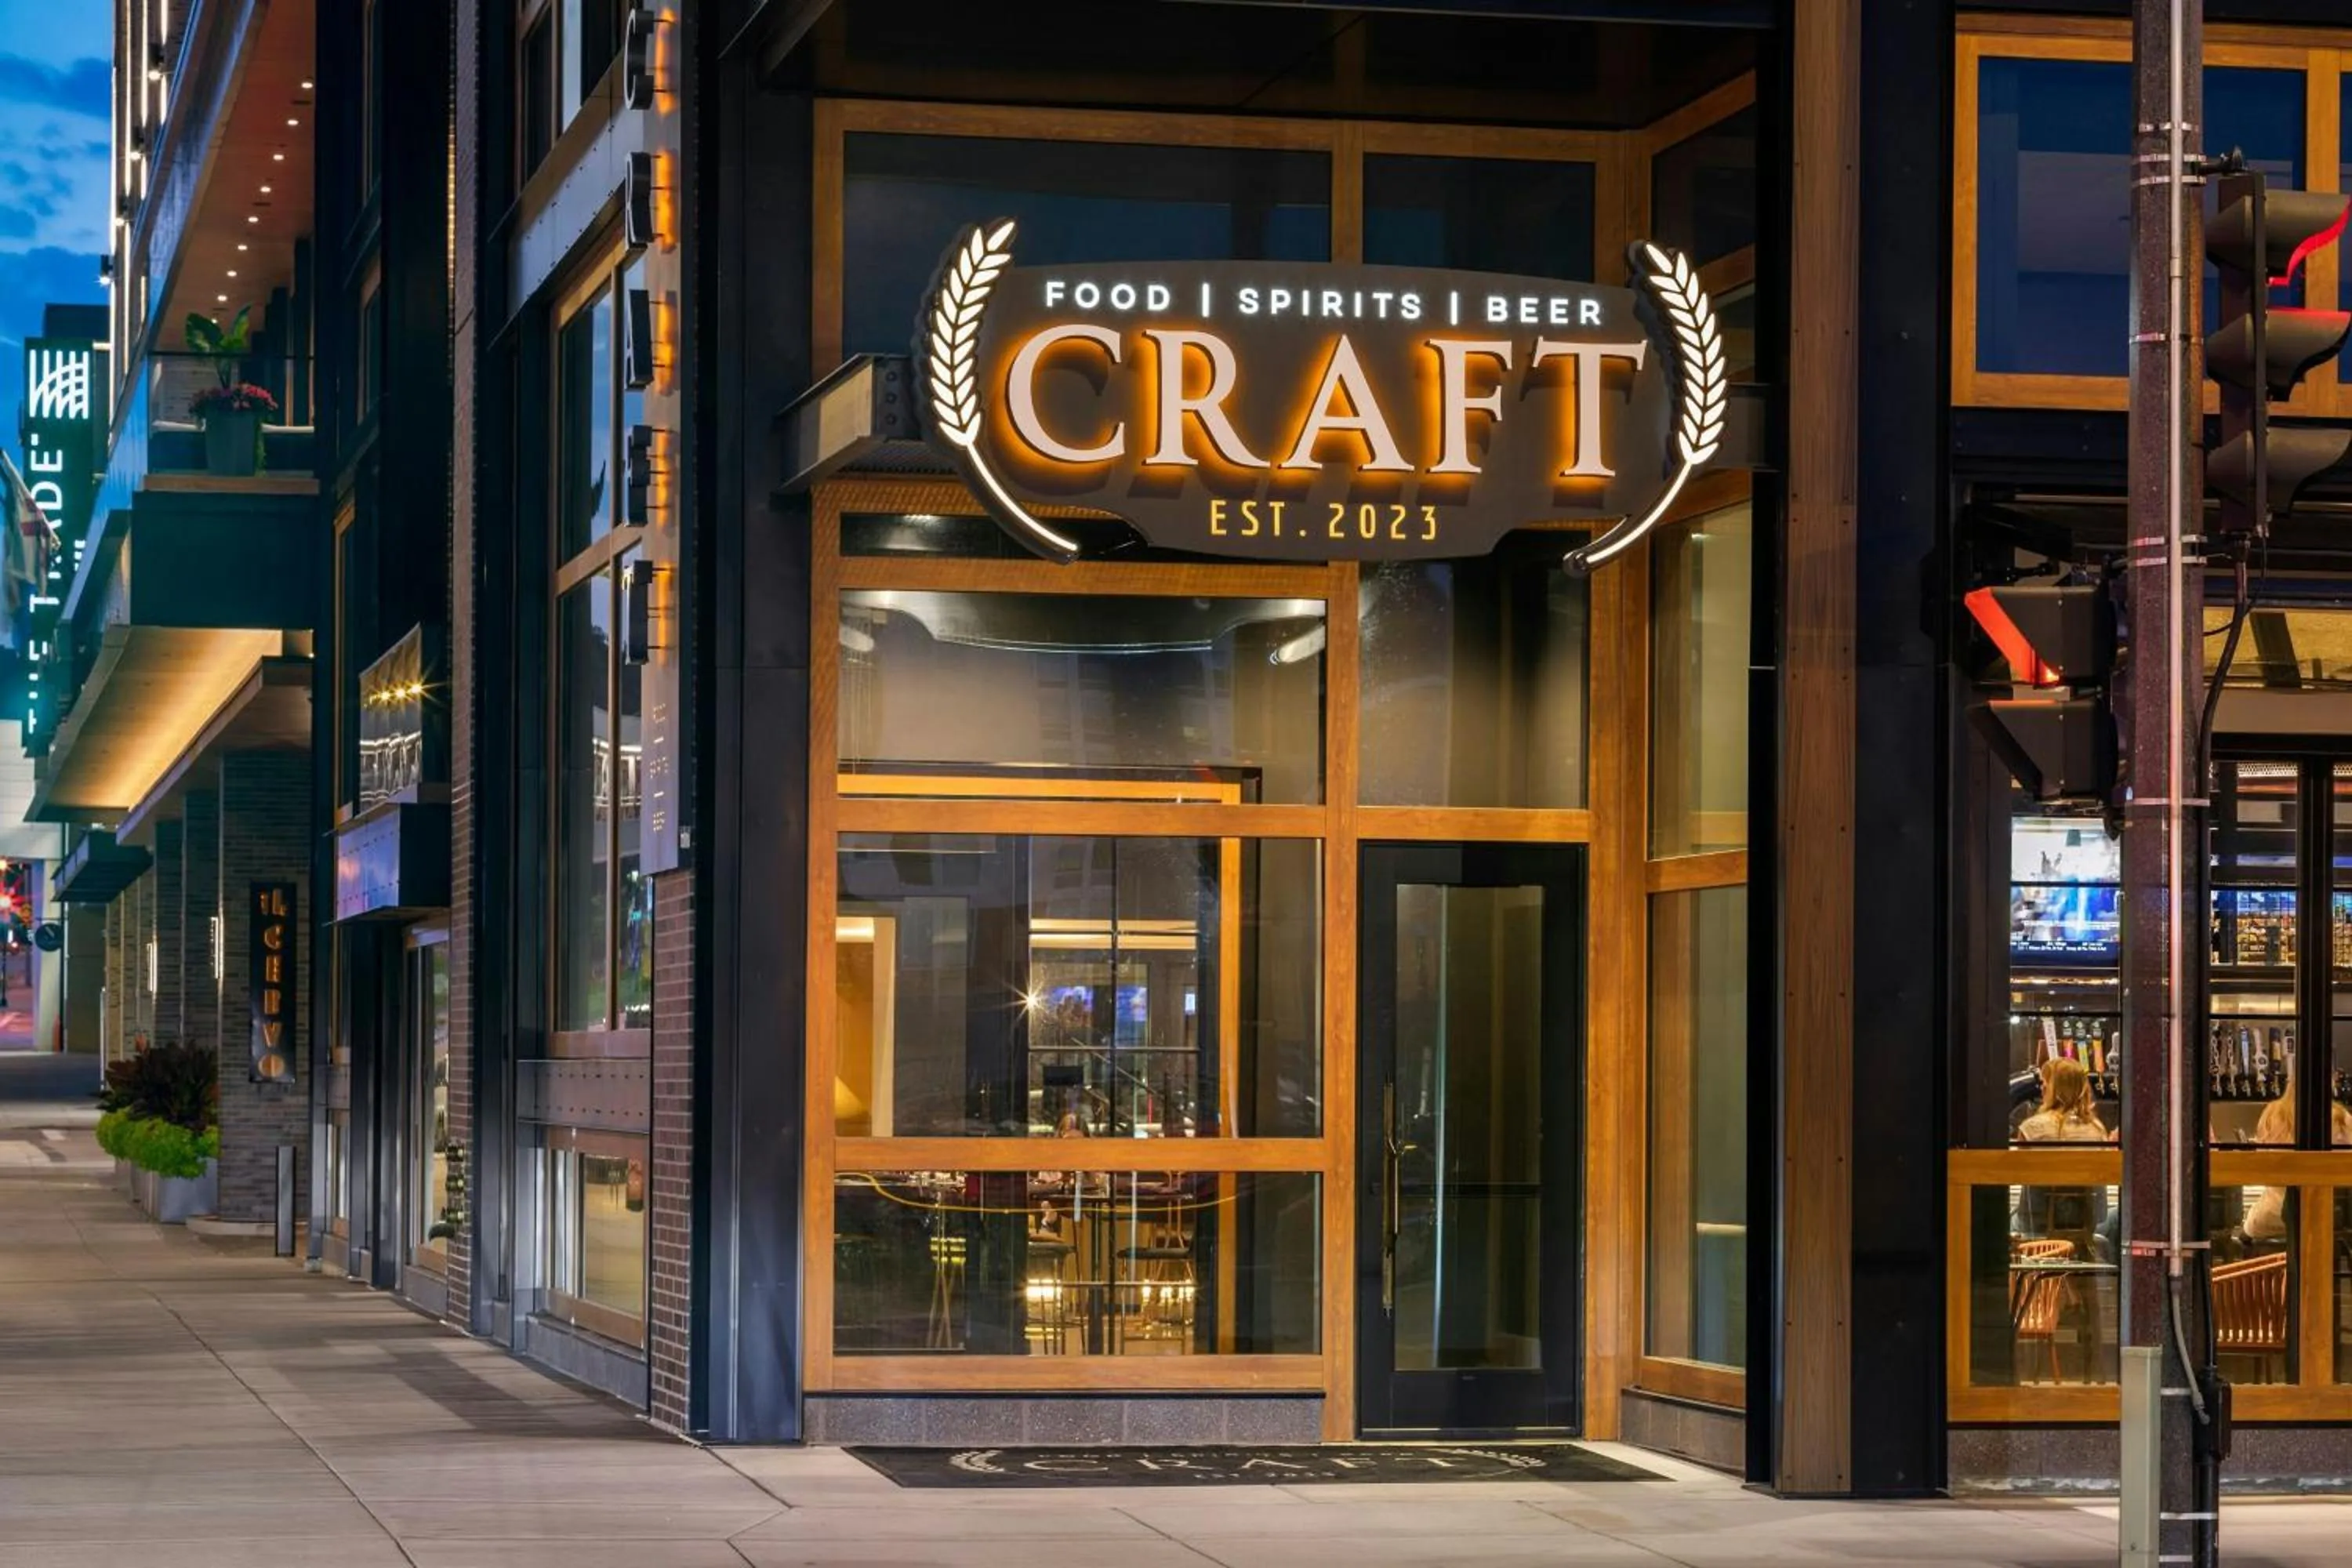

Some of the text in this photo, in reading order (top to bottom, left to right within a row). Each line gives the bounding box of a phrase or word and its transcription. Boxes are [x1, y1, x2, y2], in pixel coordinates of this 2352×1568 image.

[1045, 281, 1171, 311] FOOD
[1239, 288, 1421, 320] SPIRITS
[1488, 296, 1601, 325] BEER
[1007, 324, 1648, 477] CRAFT
[1210, 499, 1436, 540] EST. 2023
[1023, 1457, 1465, 1472] CRAFT
